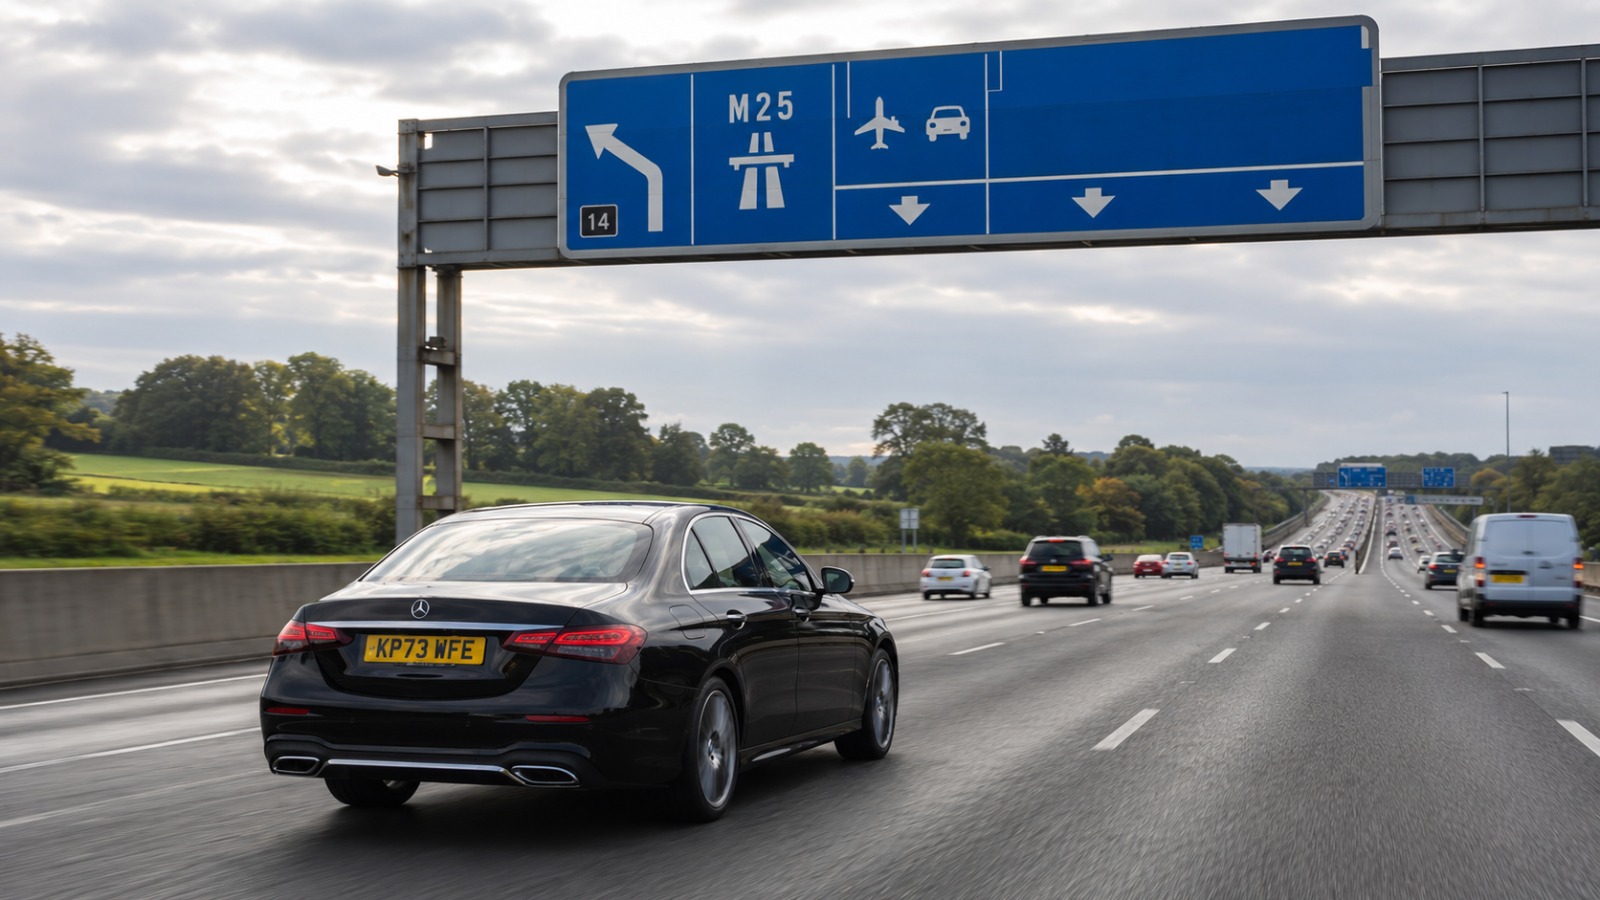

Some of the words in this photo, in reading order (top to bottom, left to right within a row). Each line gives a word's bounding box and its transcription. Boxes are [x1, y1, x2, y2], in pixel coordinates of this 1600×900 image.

[729, 91, 793, 123] M25
[588, 212, 610, 231] 14
[375, 638, 429, 658] KP73
[434, 639, 475, 660] WFE
